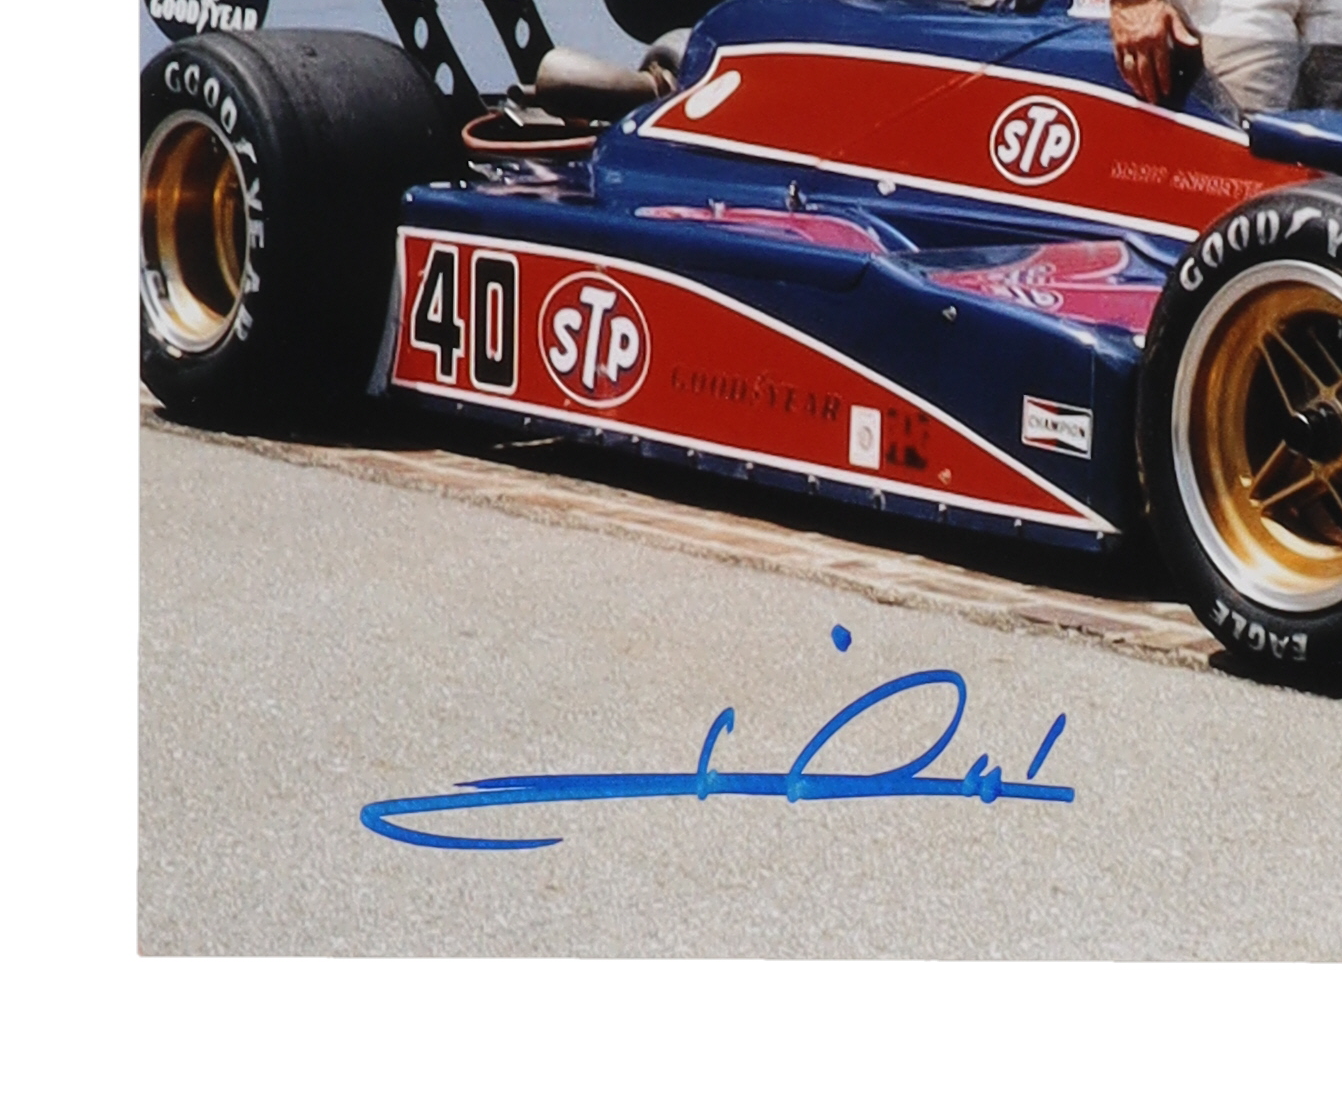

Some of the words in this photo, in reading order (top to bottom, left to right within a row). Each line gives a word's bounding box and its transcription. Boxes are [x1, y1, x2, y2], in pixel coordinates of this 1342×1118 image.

[997, 105, 1072, 174] STP
[411, 242, 520, 396] 40
[549, 285, 640, 390] STP
[1208, 598, 1308, 661] EAGLE
